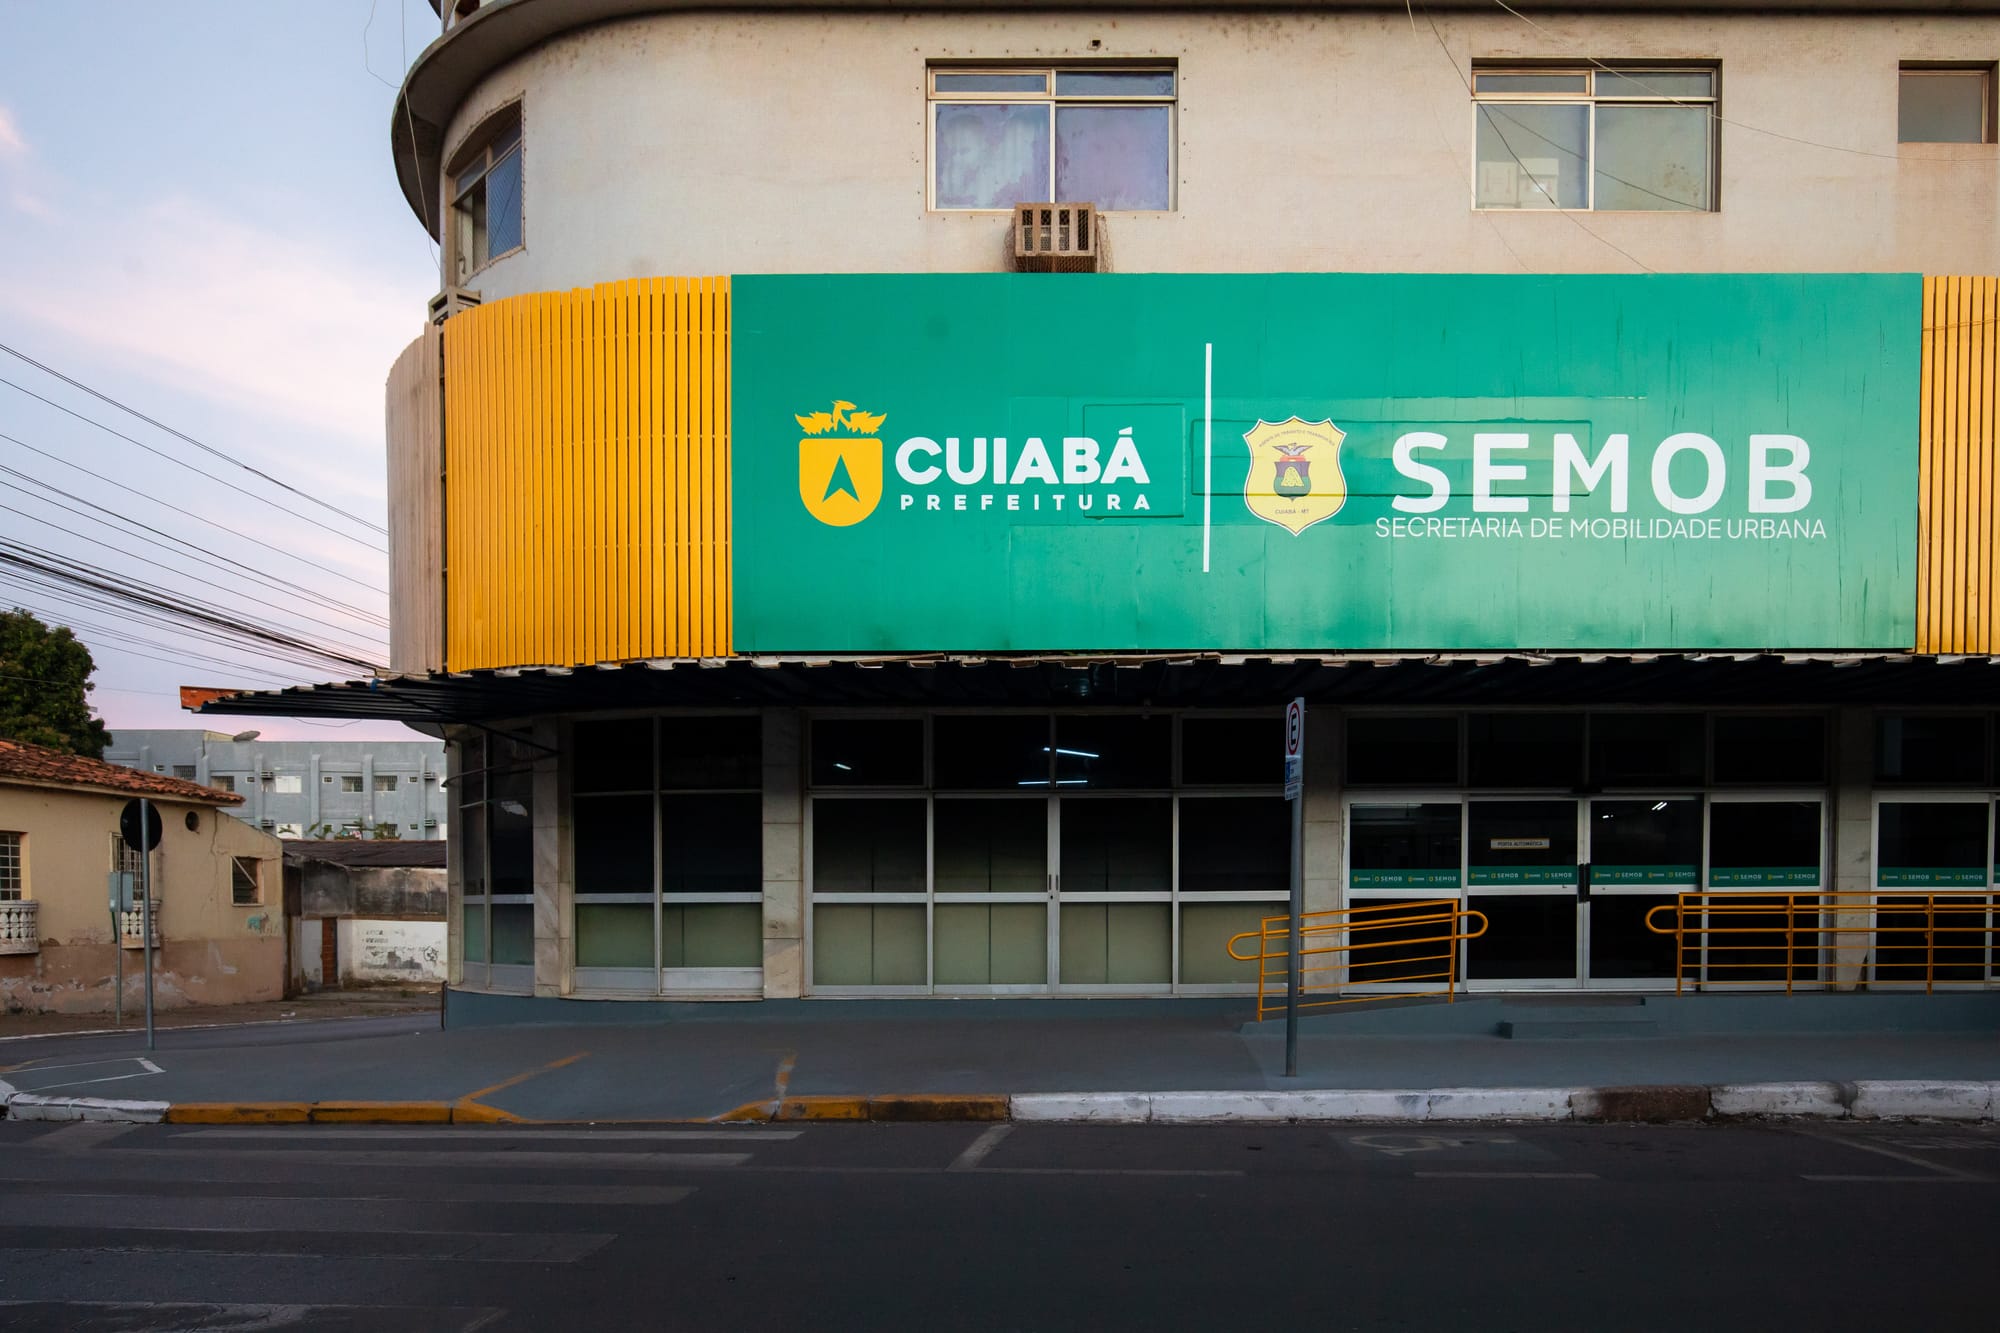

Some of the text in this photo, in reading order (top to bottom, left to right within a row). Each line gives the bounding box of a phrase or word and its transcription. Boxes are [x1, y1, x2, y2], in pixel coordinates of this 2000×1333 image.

[895, 426, 1150, 485] CUIABÁ
[1391, 431, 1812, 514] SEMOB
[900, 494, 1150, 511] PREFEITURA
[1375, 516, 1826, 539] SECRETARIA DE MOBILIDADE URBANA
